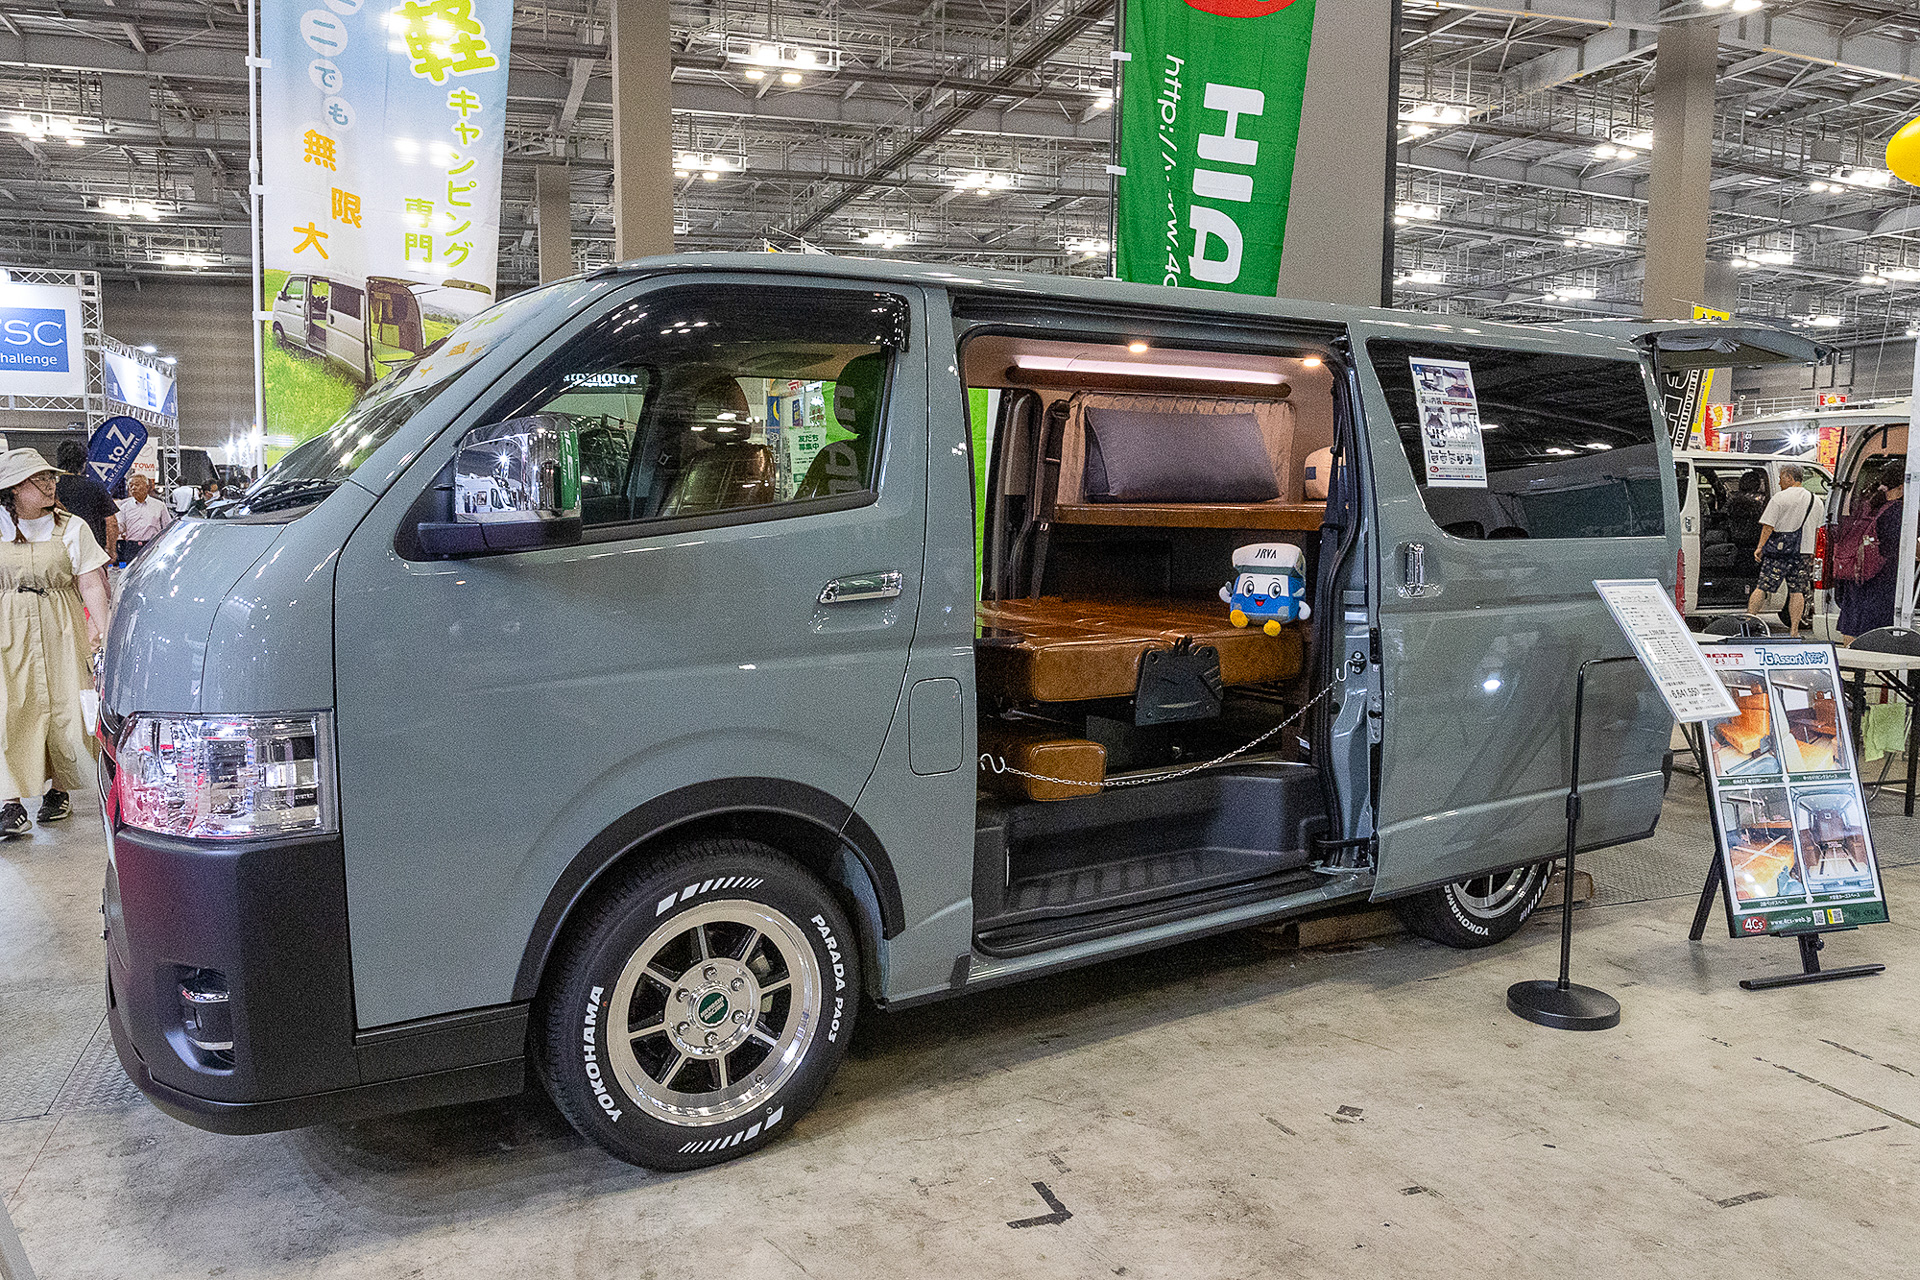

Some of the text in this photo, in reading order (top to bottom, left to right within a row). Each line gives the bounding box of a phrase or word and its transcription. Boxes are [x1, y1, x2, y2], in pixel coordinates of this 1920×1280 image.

[1188, 82, 1265, 284] HIA
[0, 319, 64, 347] SC
[811, 914, 846, 992] PARADA
[1744, 918, 1764, 930] 4Cs
[583, 986, 623, 1123] YOKOHAMA
